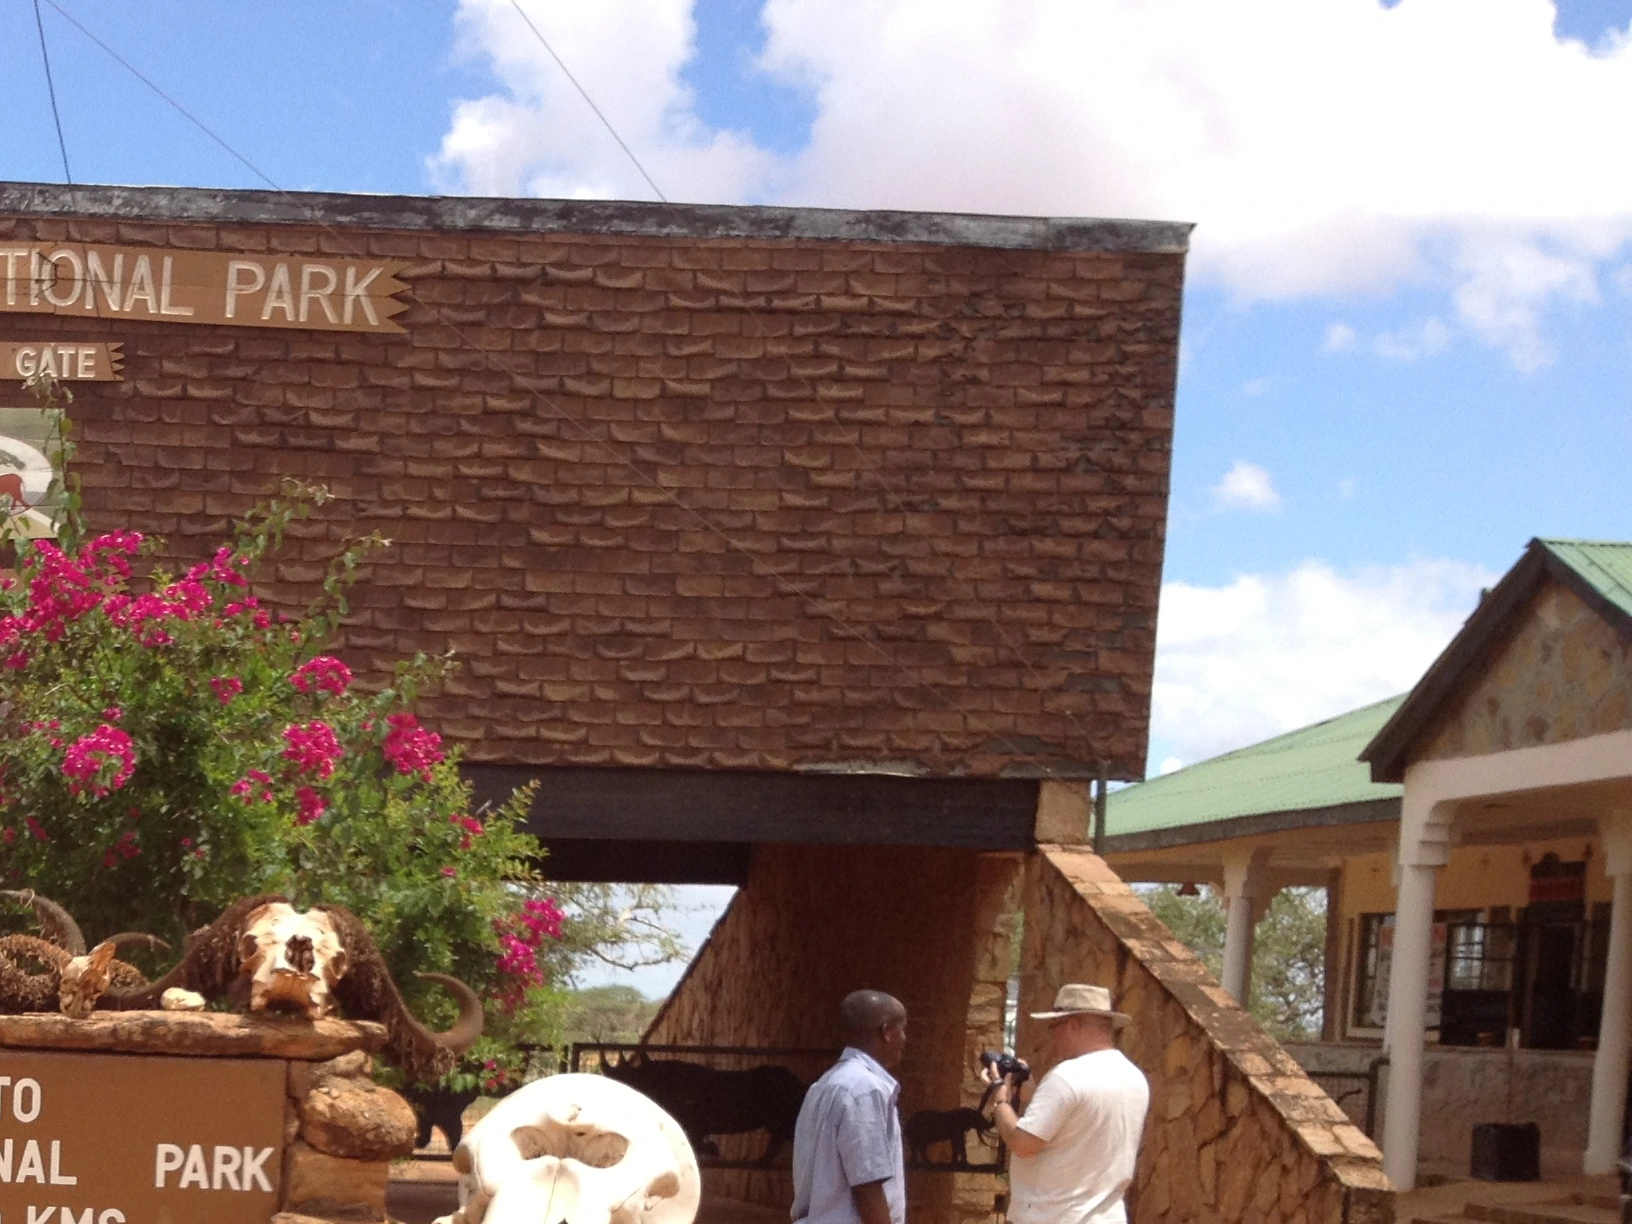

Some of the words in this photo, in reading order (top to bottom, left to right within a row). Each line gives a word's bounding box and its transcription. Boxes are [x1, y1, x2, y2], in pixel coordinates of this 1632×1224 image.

[226, 261, 382, 325] PARK
[15, 346, 96, 378] GATE
[156, 1144, 273, 1191] PARK
